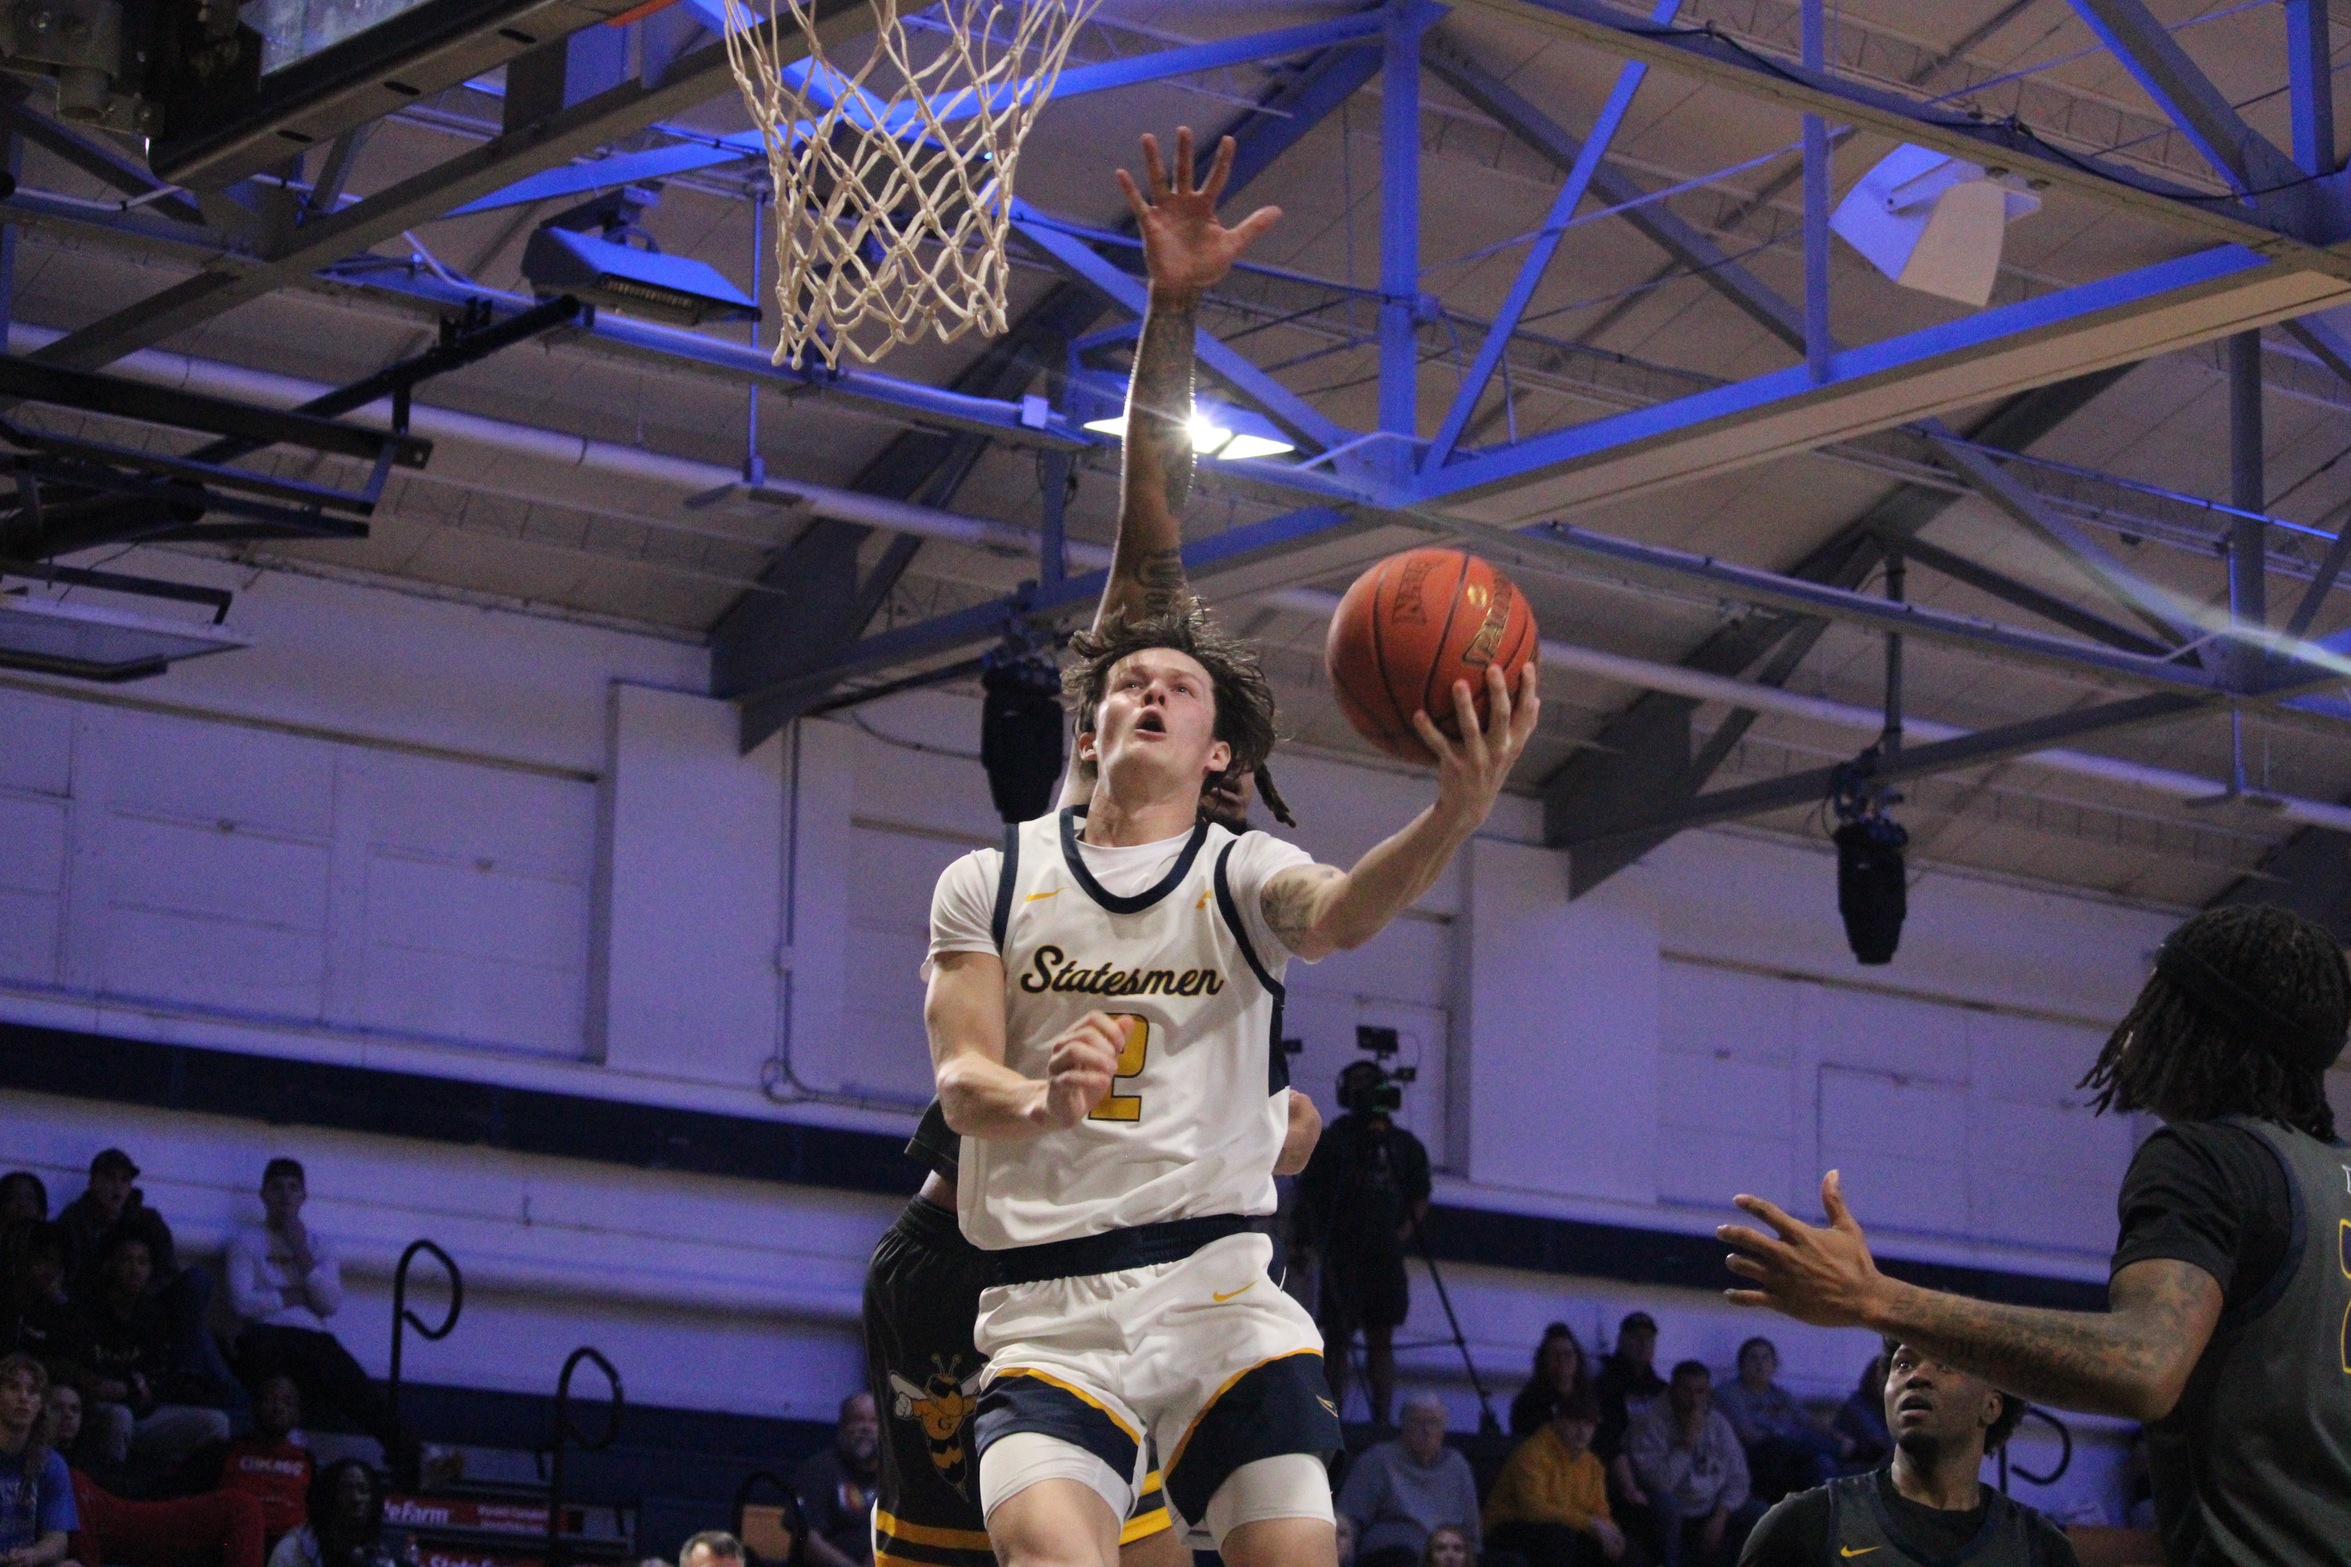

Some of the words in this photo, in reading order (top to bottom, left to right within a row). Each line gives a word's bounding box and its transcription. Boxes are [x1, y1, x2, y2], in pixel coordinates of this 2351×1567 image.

[1020, 945, 1224, 996] Statesmen
[1088, 1012, 1150, 1122] 2
[938, 1416, 953, 1431] G
